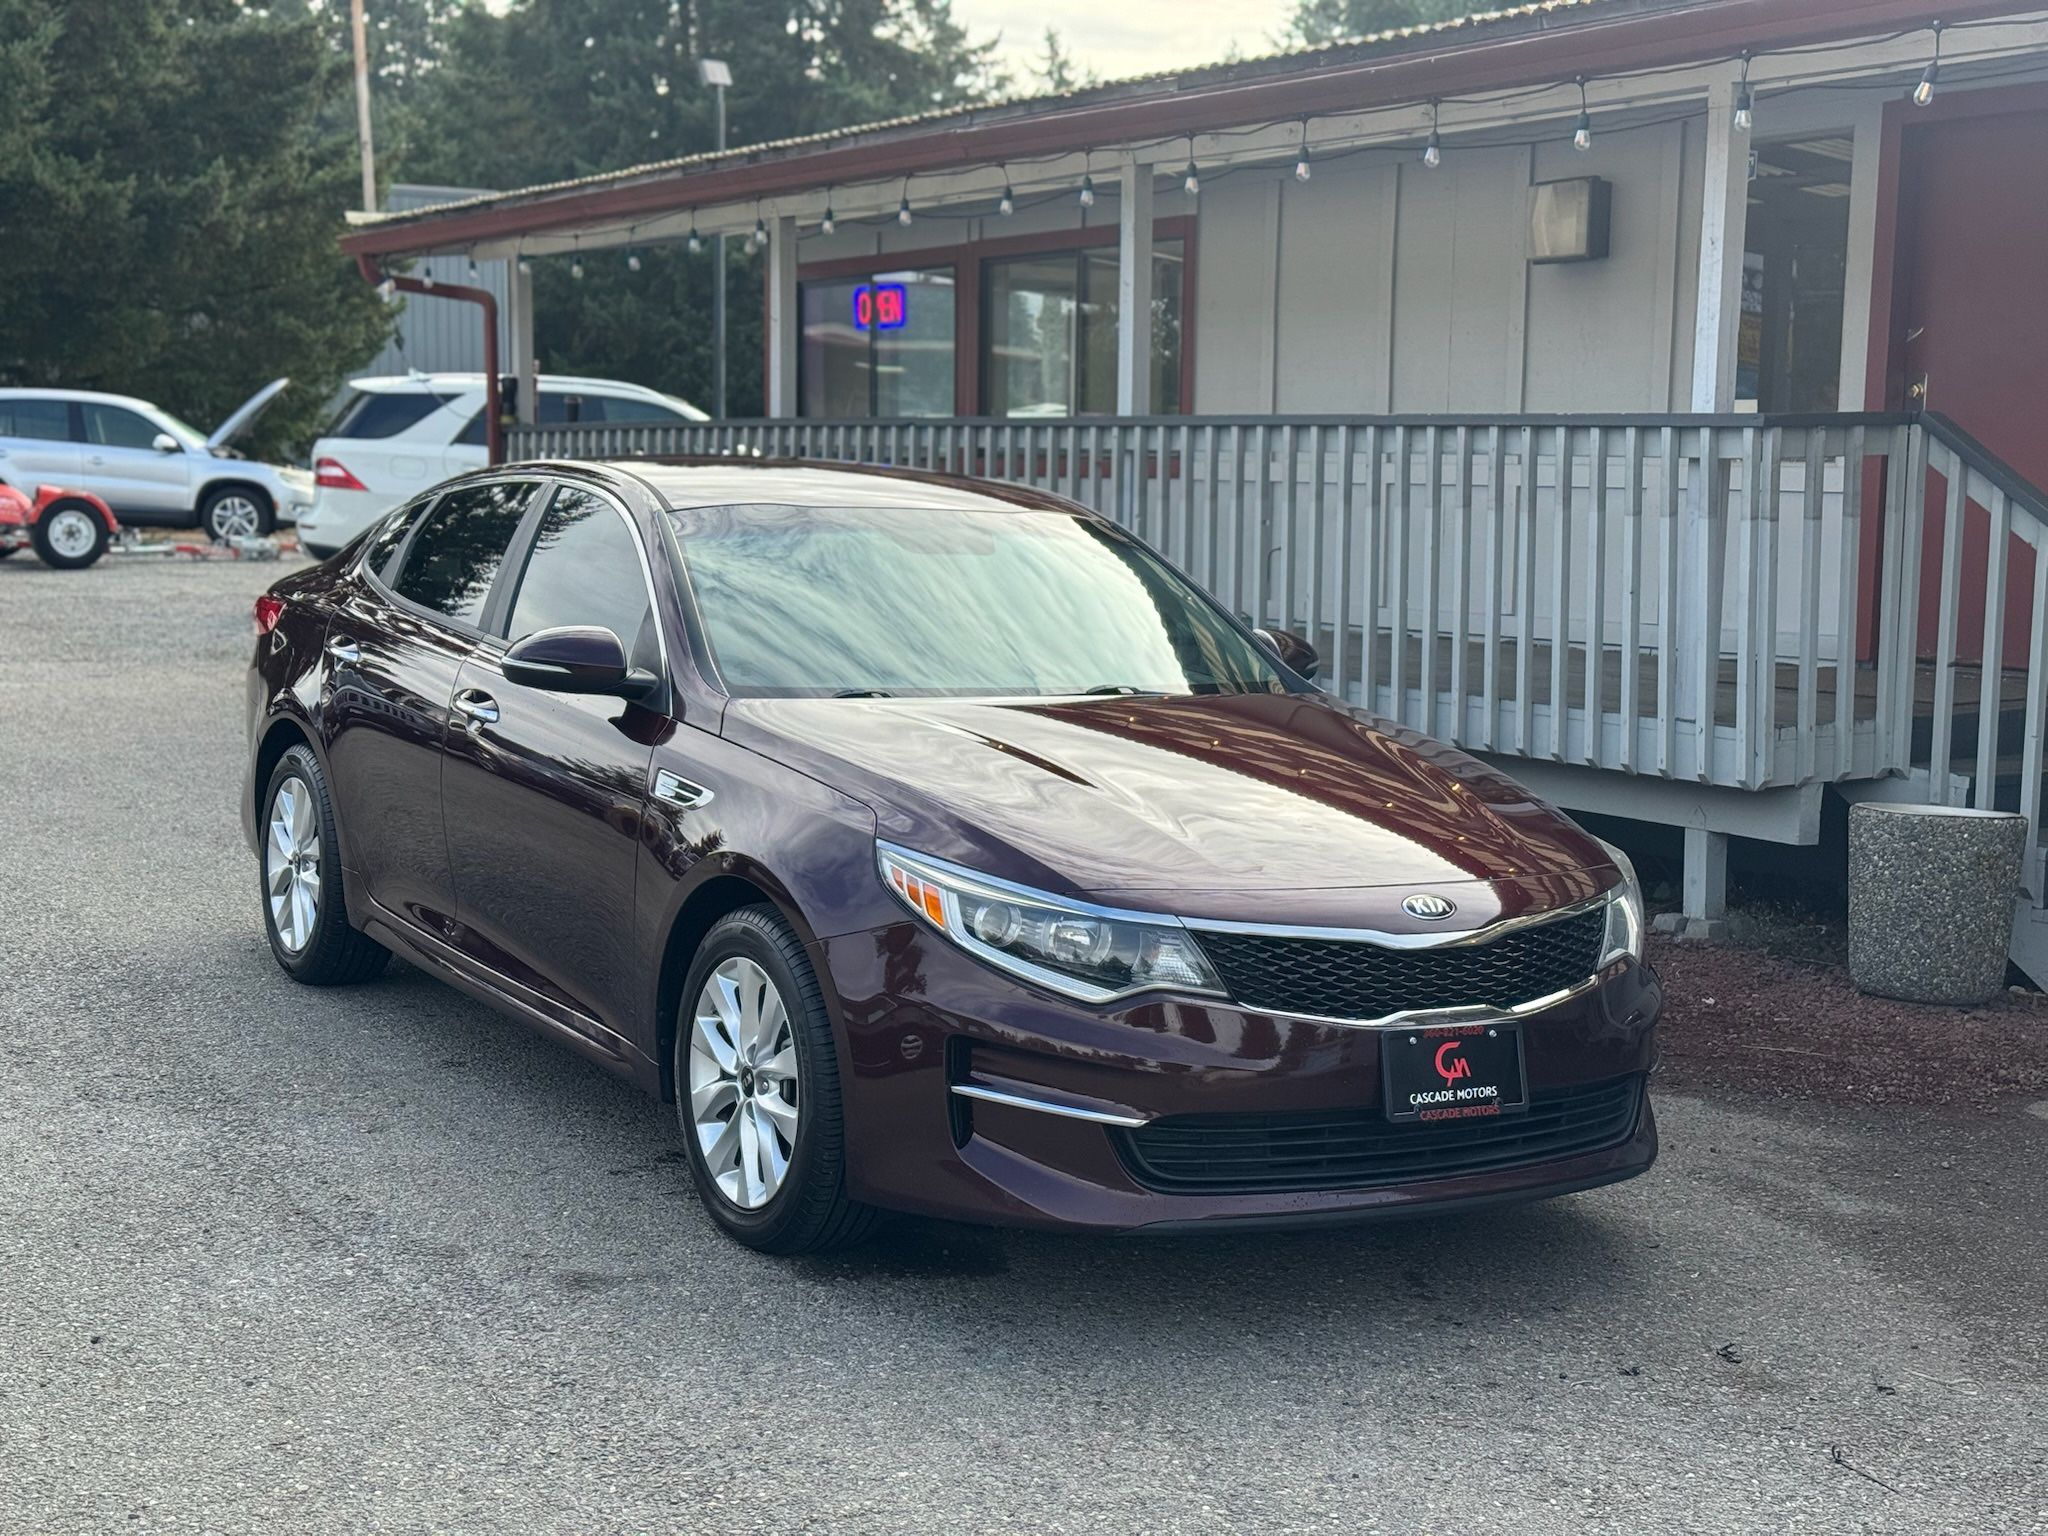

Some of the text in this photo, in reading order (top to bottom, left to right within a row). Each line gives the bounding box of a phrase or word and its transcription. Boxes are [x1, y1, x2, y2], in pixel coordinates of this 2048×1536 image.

[1409, 896, 1451, 914] KIA
[1409, 1085, 1498, 1105] CASCADE MOTORS
[1419, 1104, 1501, 1121] CASCADE MOTORS
